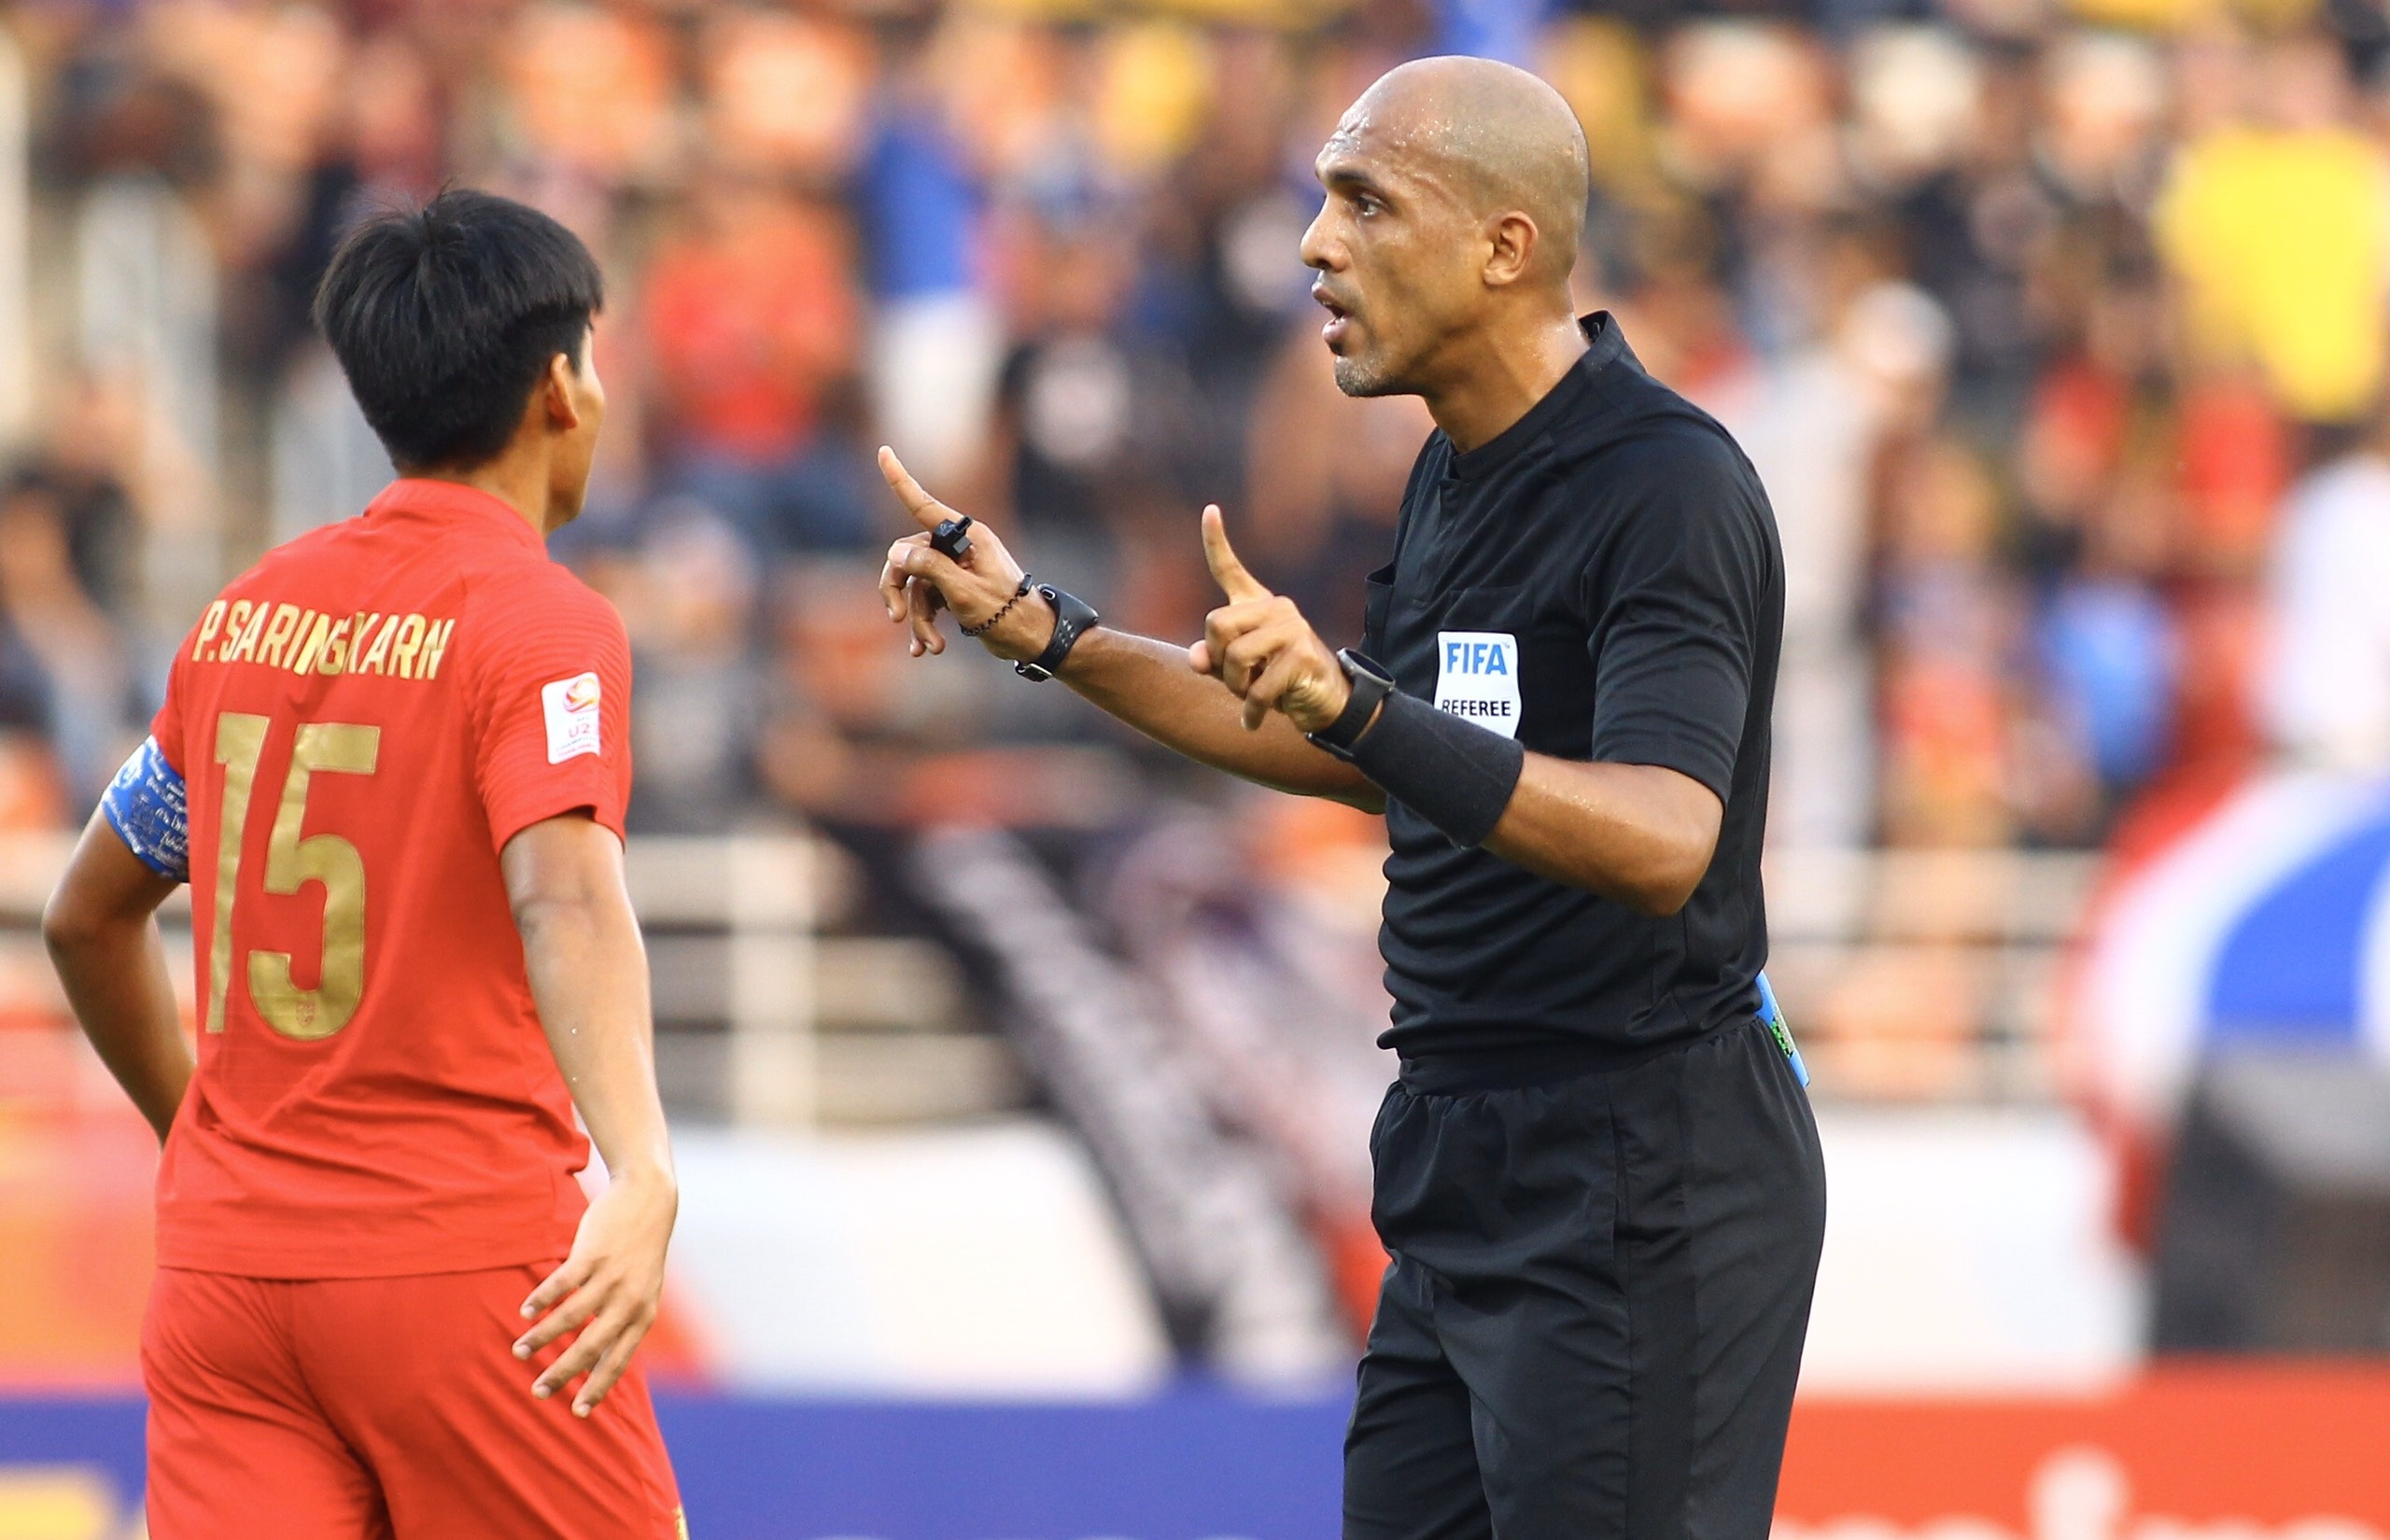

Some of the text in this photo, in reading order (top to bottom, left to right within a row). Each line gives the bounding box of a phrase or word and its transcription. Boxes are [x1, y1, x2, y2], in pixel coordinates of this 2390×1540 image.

[1446, 642, 1508, 675] FIFA
[1441, 699, 1511, 717] REFEREE
[205, 712, 381, 1040] 15
